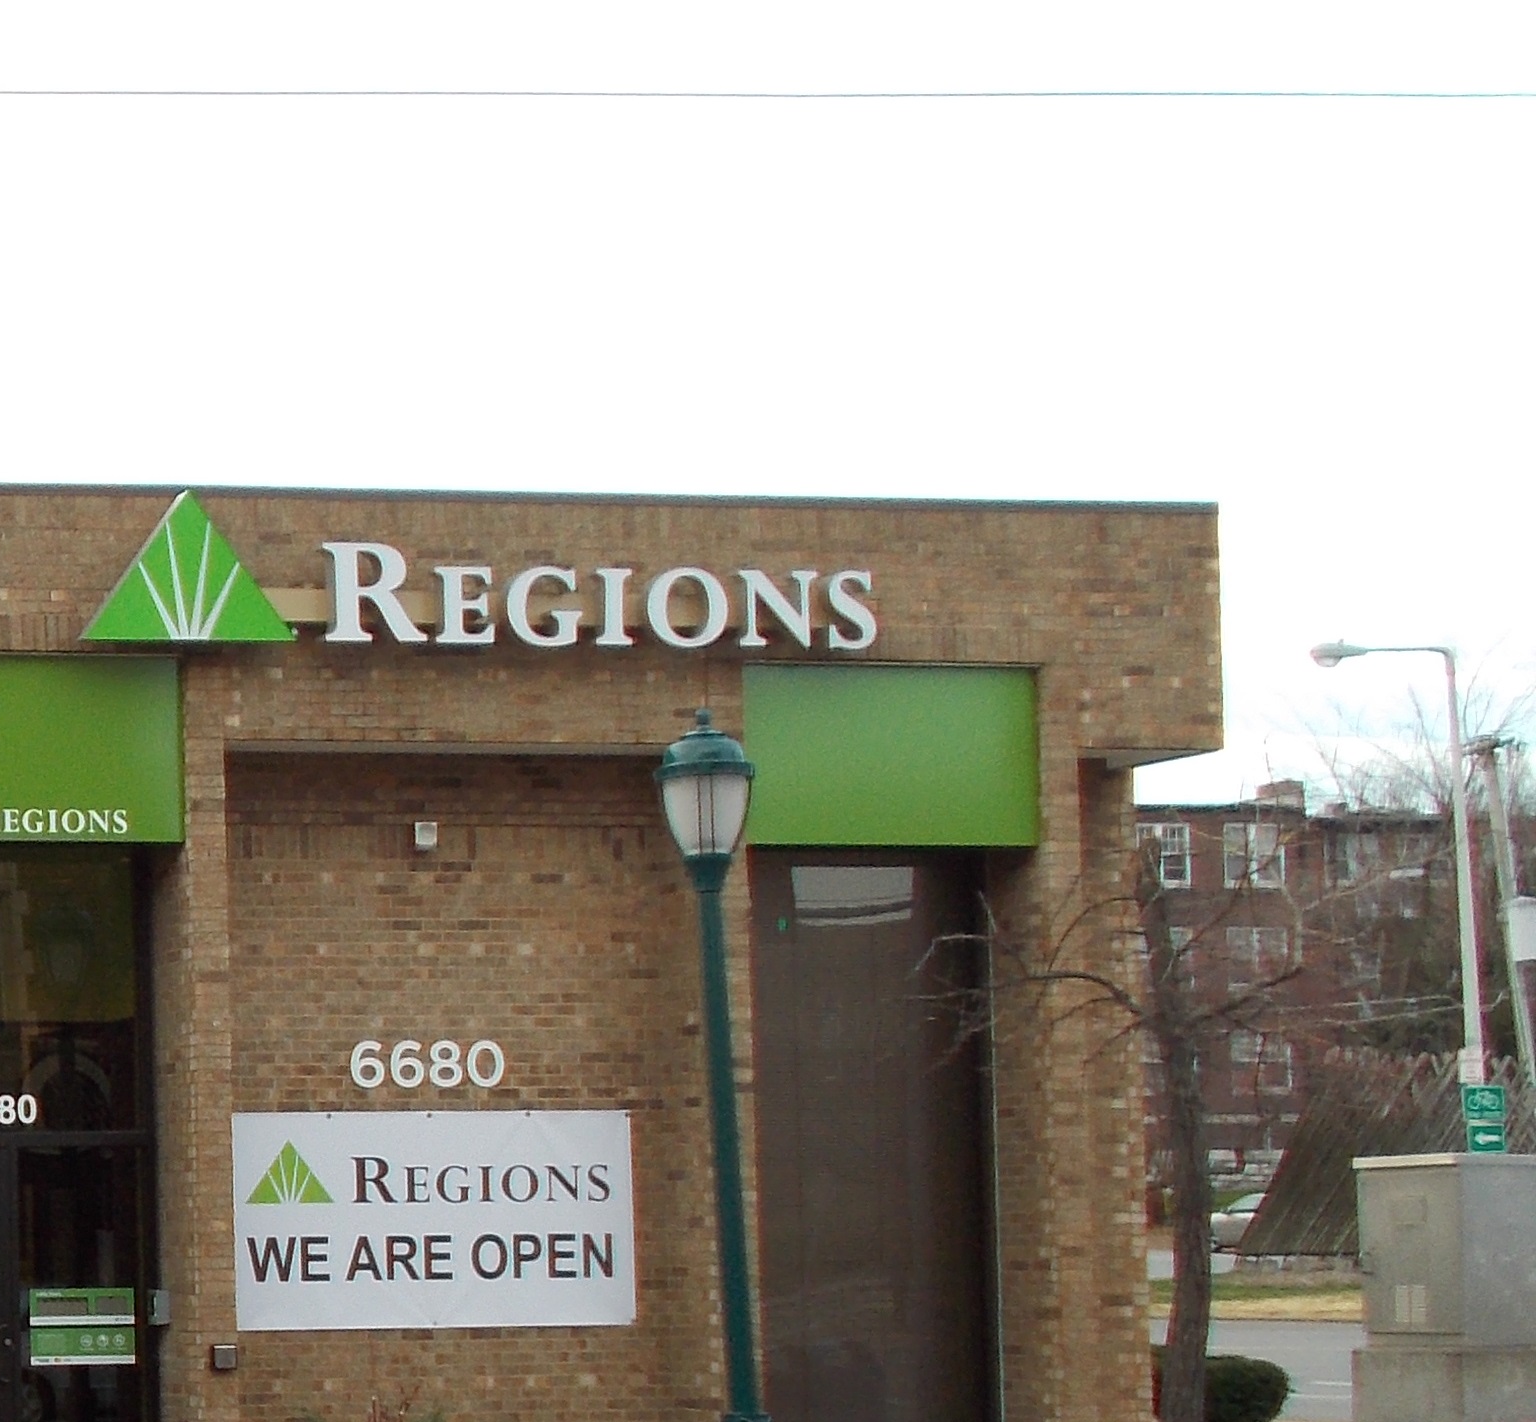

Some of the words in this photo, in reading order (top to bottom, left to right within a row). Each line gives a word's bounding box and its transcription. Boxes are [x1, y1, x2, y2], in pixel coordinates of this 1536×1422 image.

[321, 540, 878, 650] REGIONS
[349, 1039, 505, 1089] 6680
[350, 1155, 612, 1205] REGIONS
[246, 1235, 331, 1283] WE
[344, 1234, 454, 1282] ARE
[470, 1232, 614, 1281] OPEN
